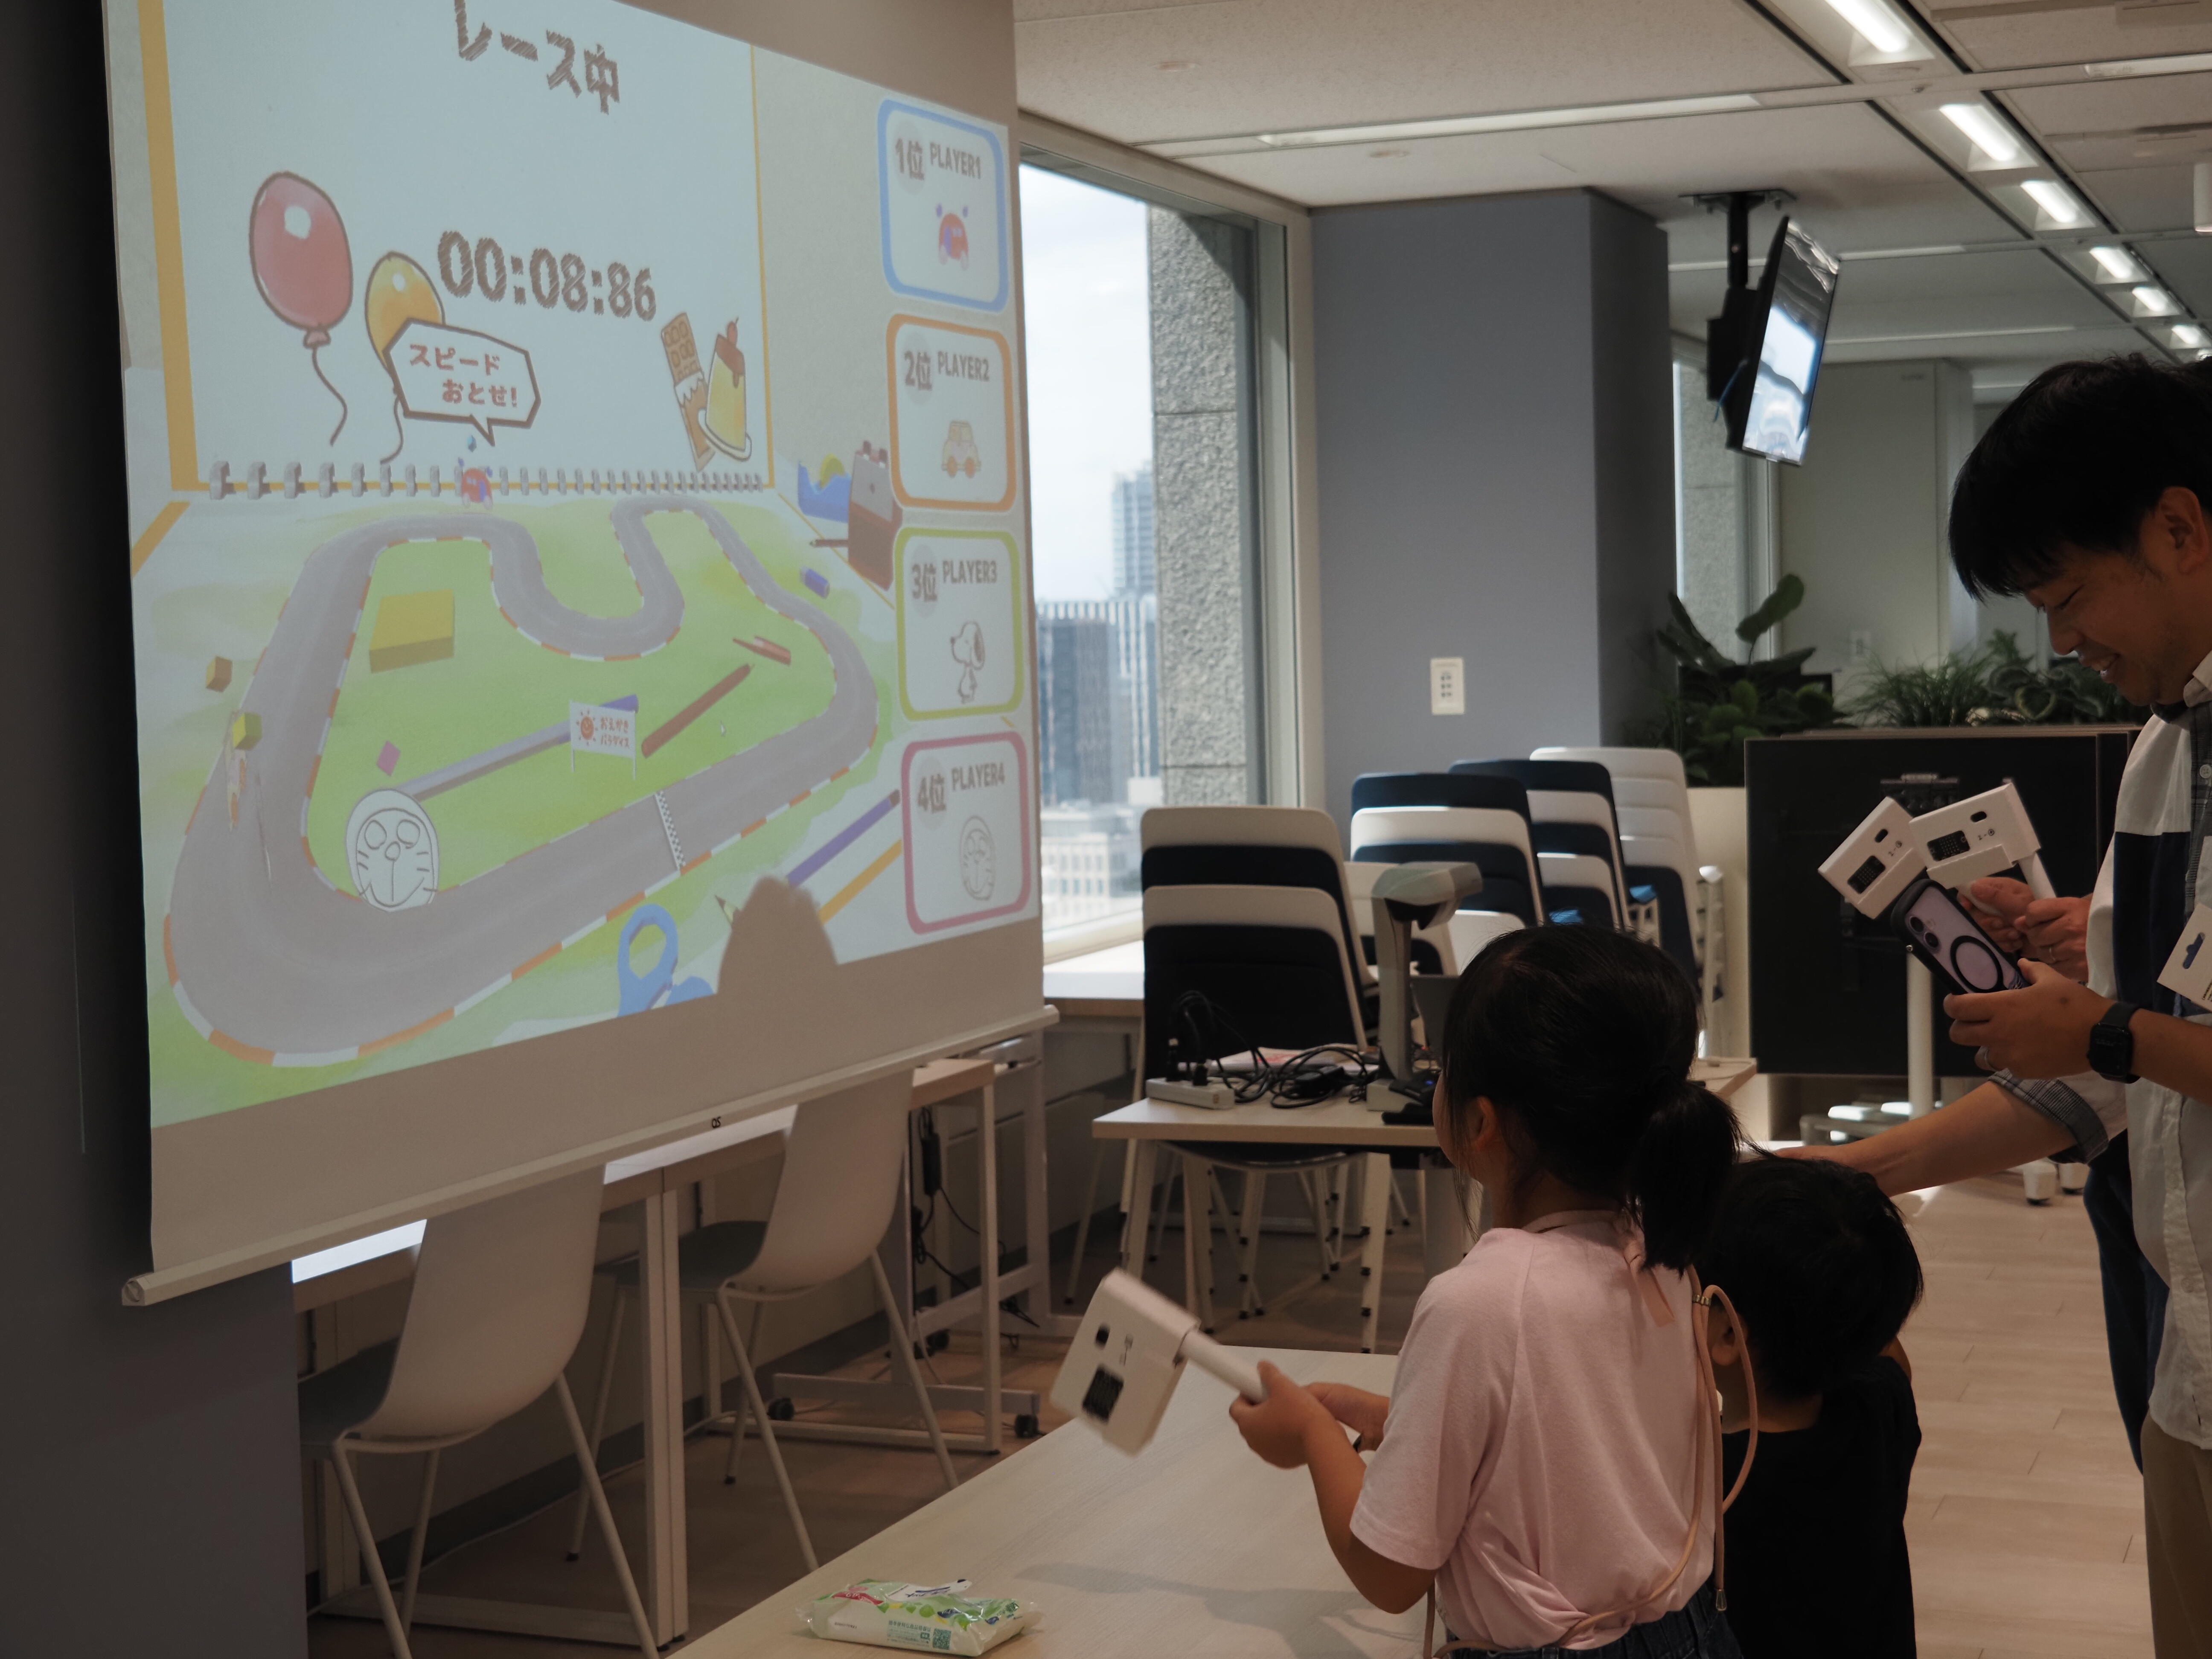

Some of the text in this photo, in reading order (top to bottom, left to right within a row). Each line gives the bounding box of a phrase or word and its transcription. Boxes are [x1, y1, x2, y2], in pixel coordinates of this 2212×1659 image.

[454, 0, 620, 115] レース中
[896, 137, 981, 181] 1位 PLAYER1
[438, 230, 656, 322] 00:08:86
[410, 344, 500, 375] スピード
[904, 350, 990, 391] 2位 PLAYER2
[912, 559, 997, 603] 3位 PLAYER3
[917, 763, 1005, 813] 4位 PLAYER4
